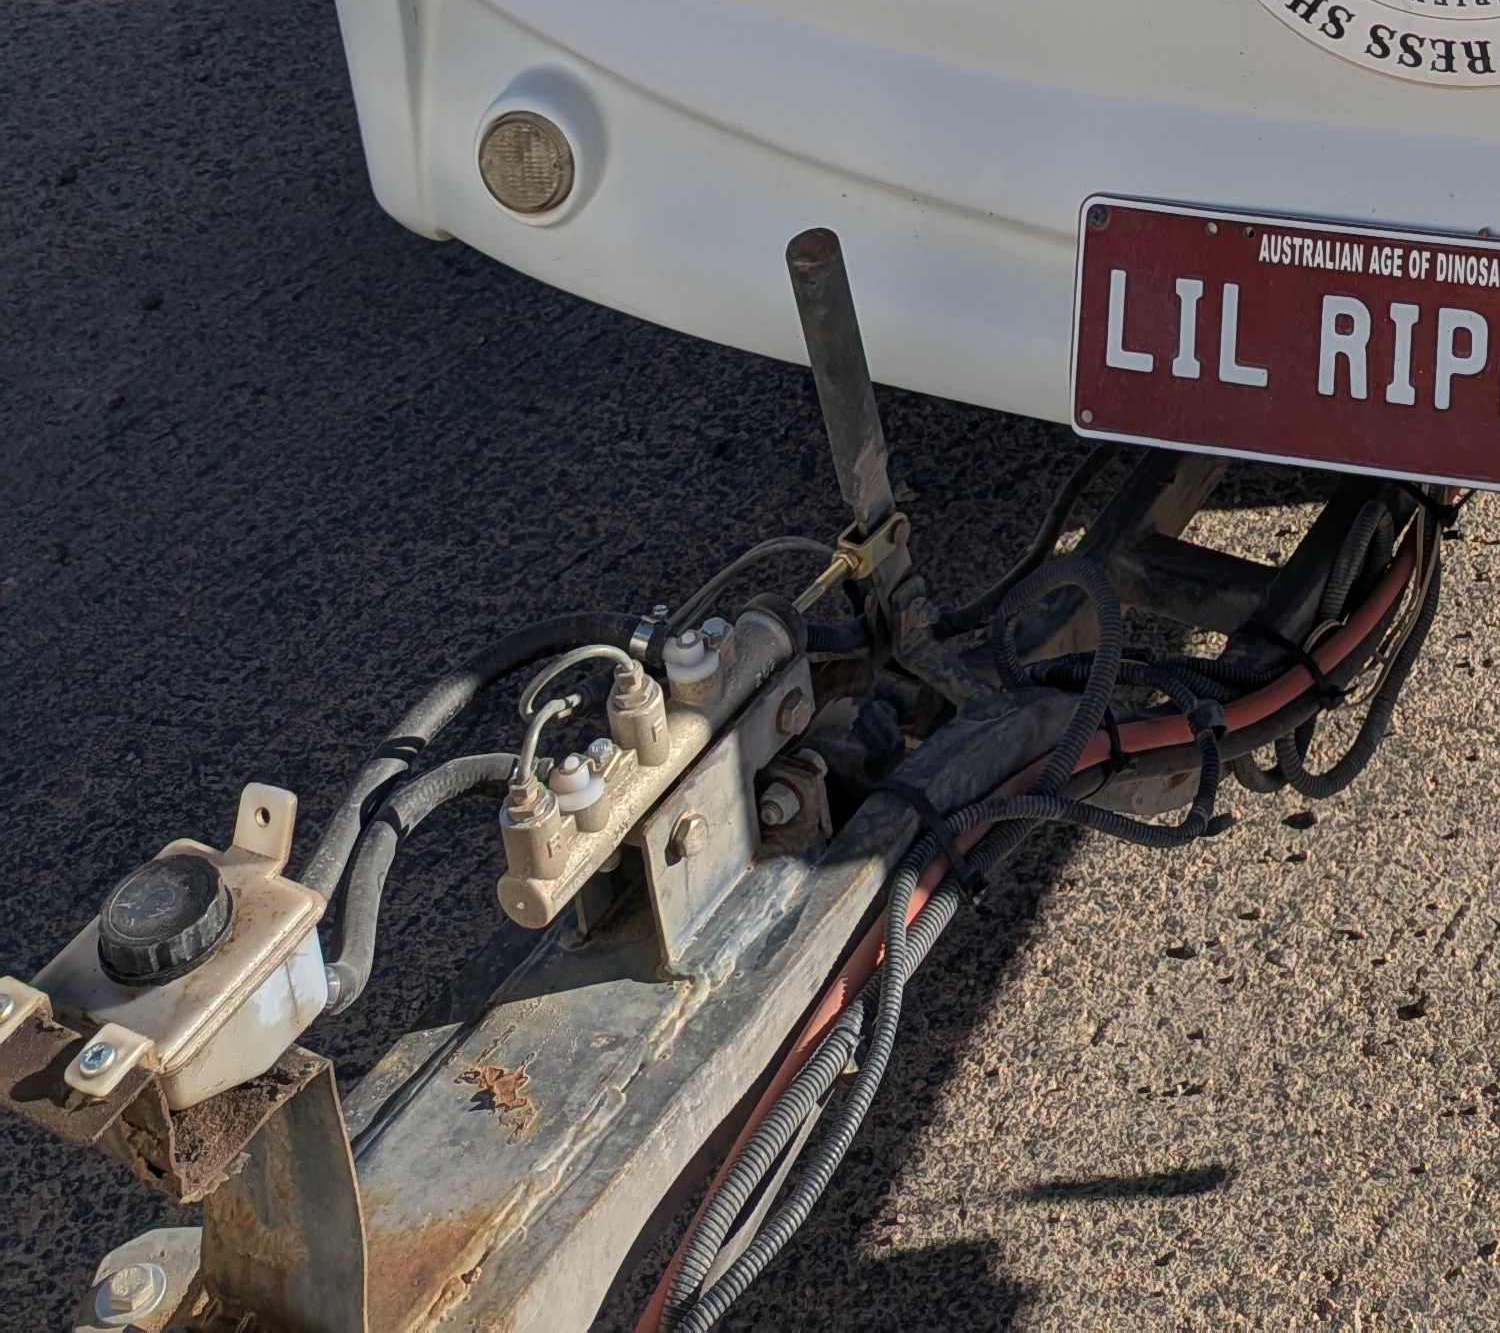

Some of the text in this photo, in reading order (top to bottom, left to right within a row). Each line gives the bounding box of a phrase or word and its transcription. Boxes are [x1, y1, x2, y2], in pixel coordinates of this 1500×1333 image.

[1258, 233, 1364, 274] AUSTRALIAN
[1368, 244, 1404, 278] AGE
[1409, 249, 1431, 280] OF
[1105, 268, 1268, 389] LIL
